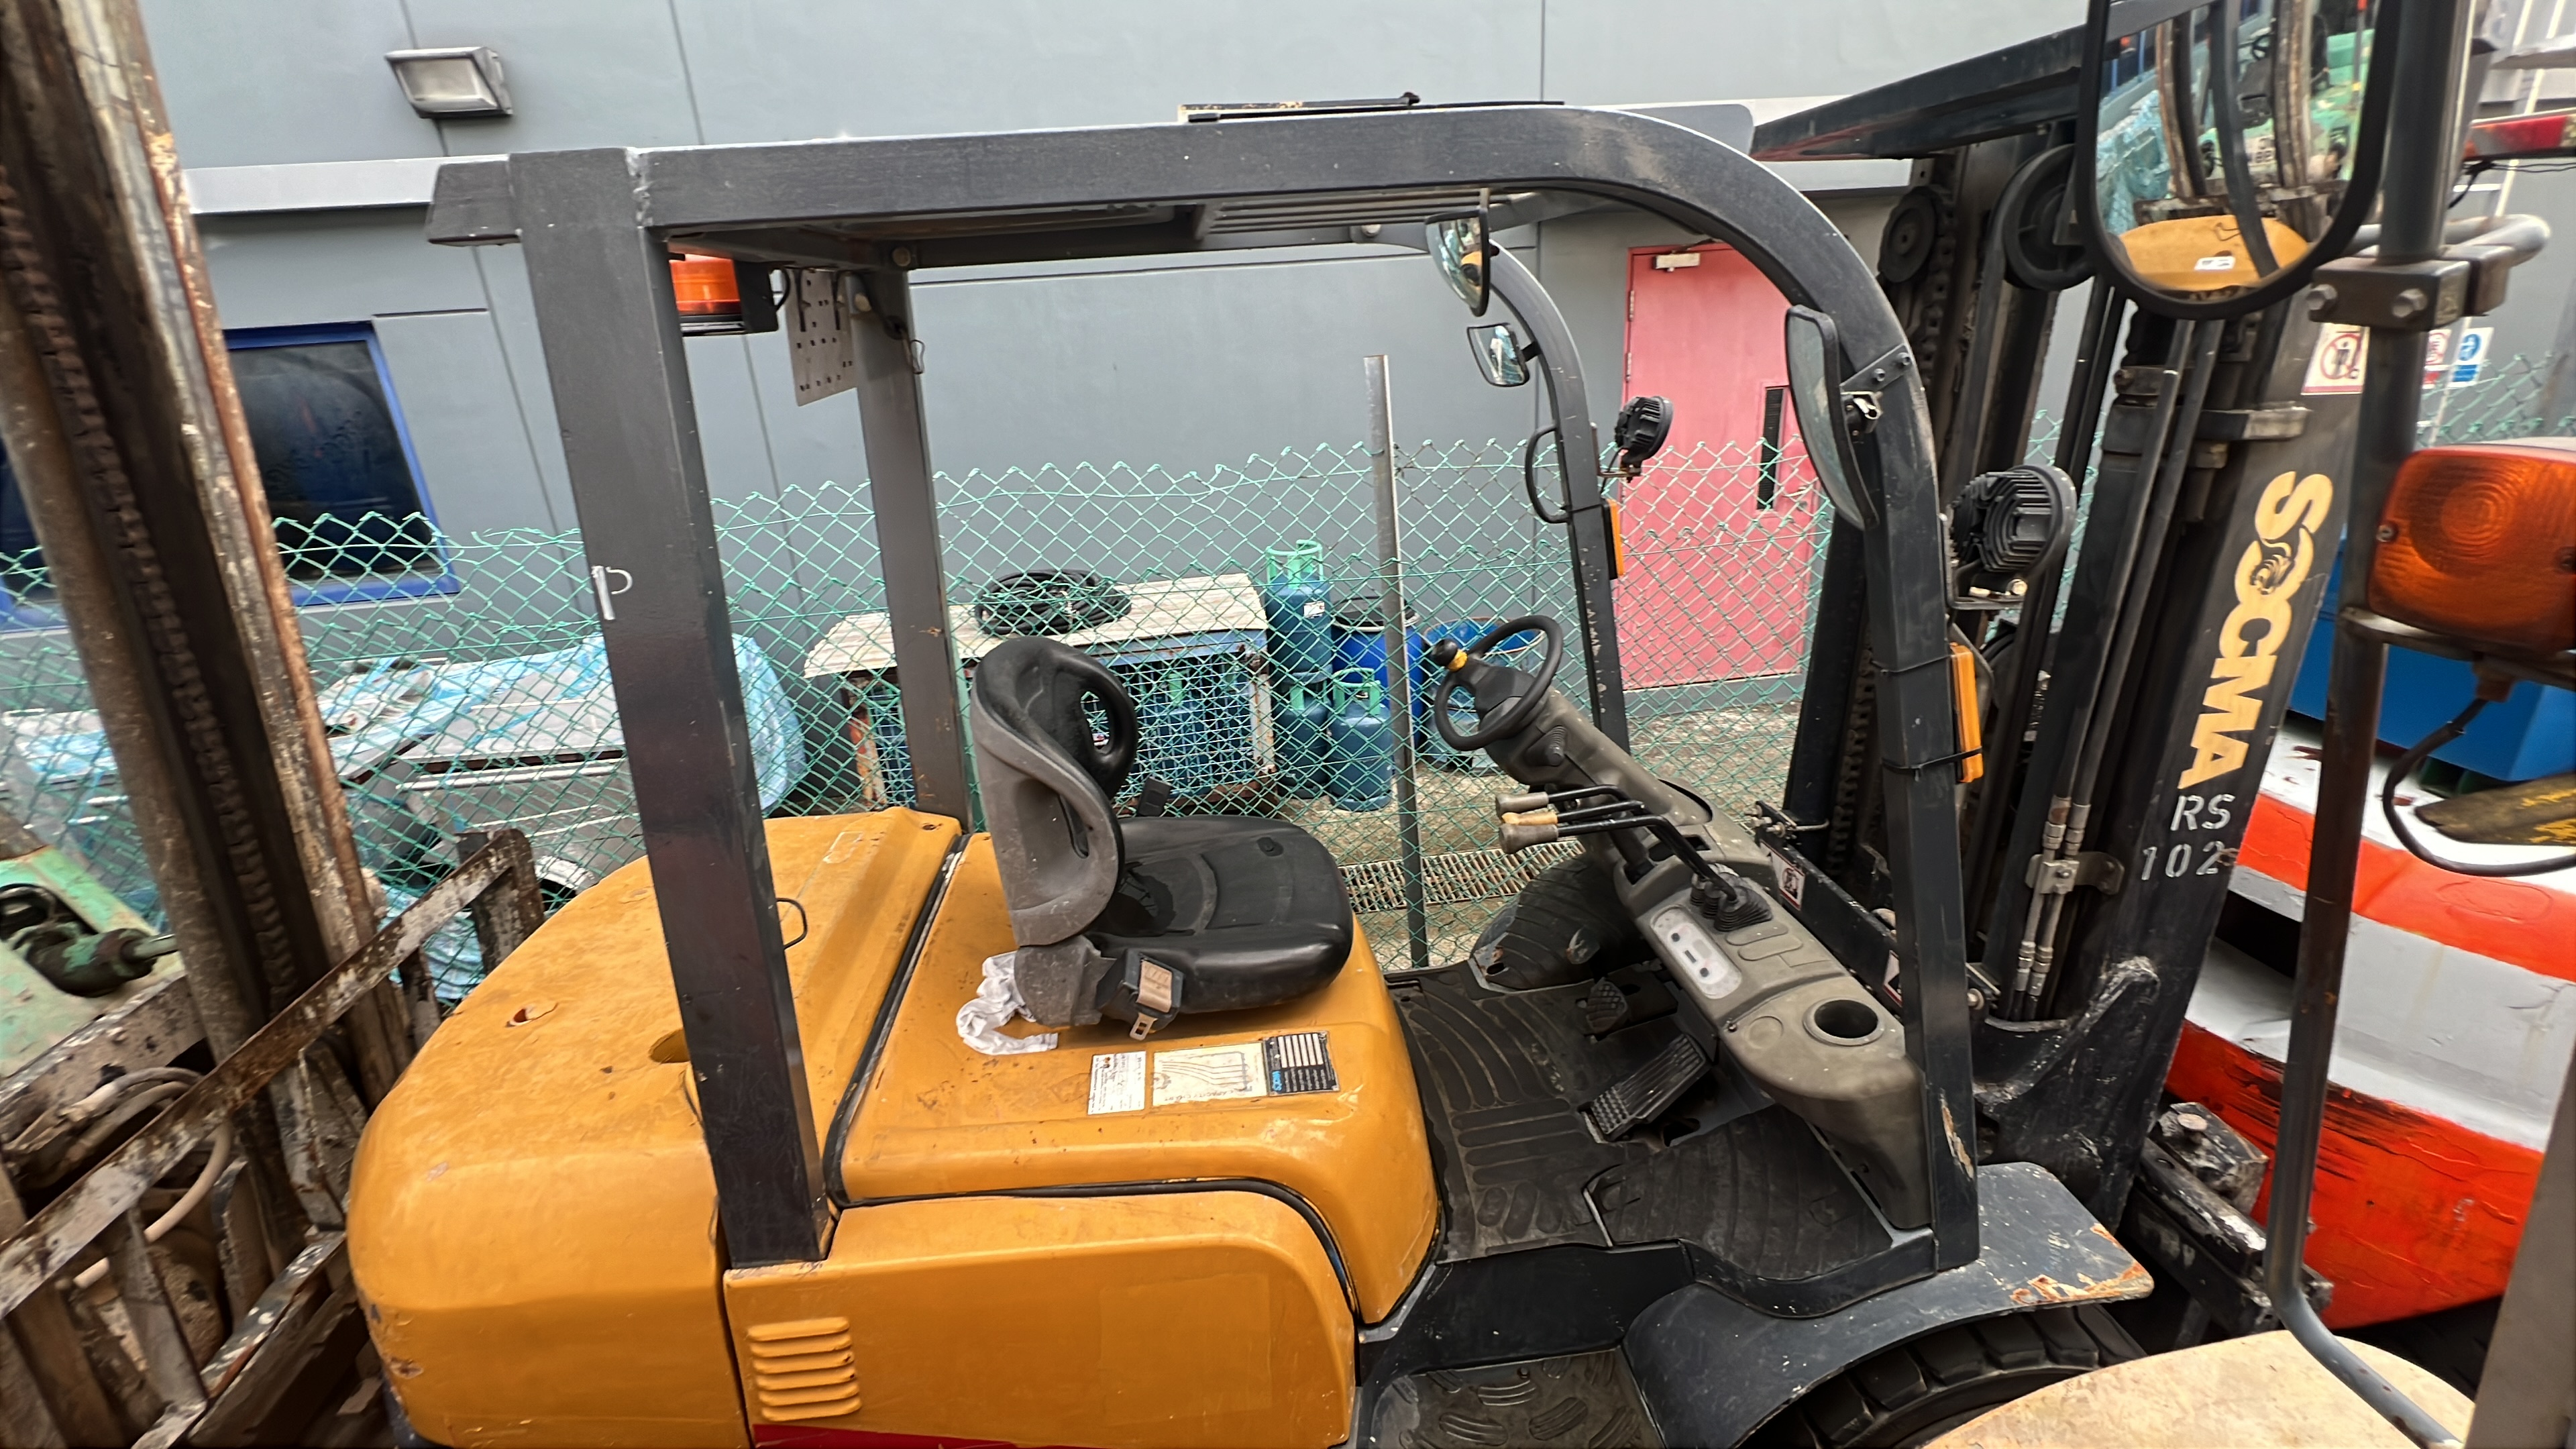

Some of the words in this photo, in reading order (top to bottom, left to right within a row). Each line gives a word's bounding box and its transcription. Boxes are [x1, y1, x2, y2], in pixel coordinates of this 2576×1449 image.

[2178, 471, 2333, 789] SOCMA
[2170, 794, 2235, 830] RS
[2141, 841, 2224, 880] 102
